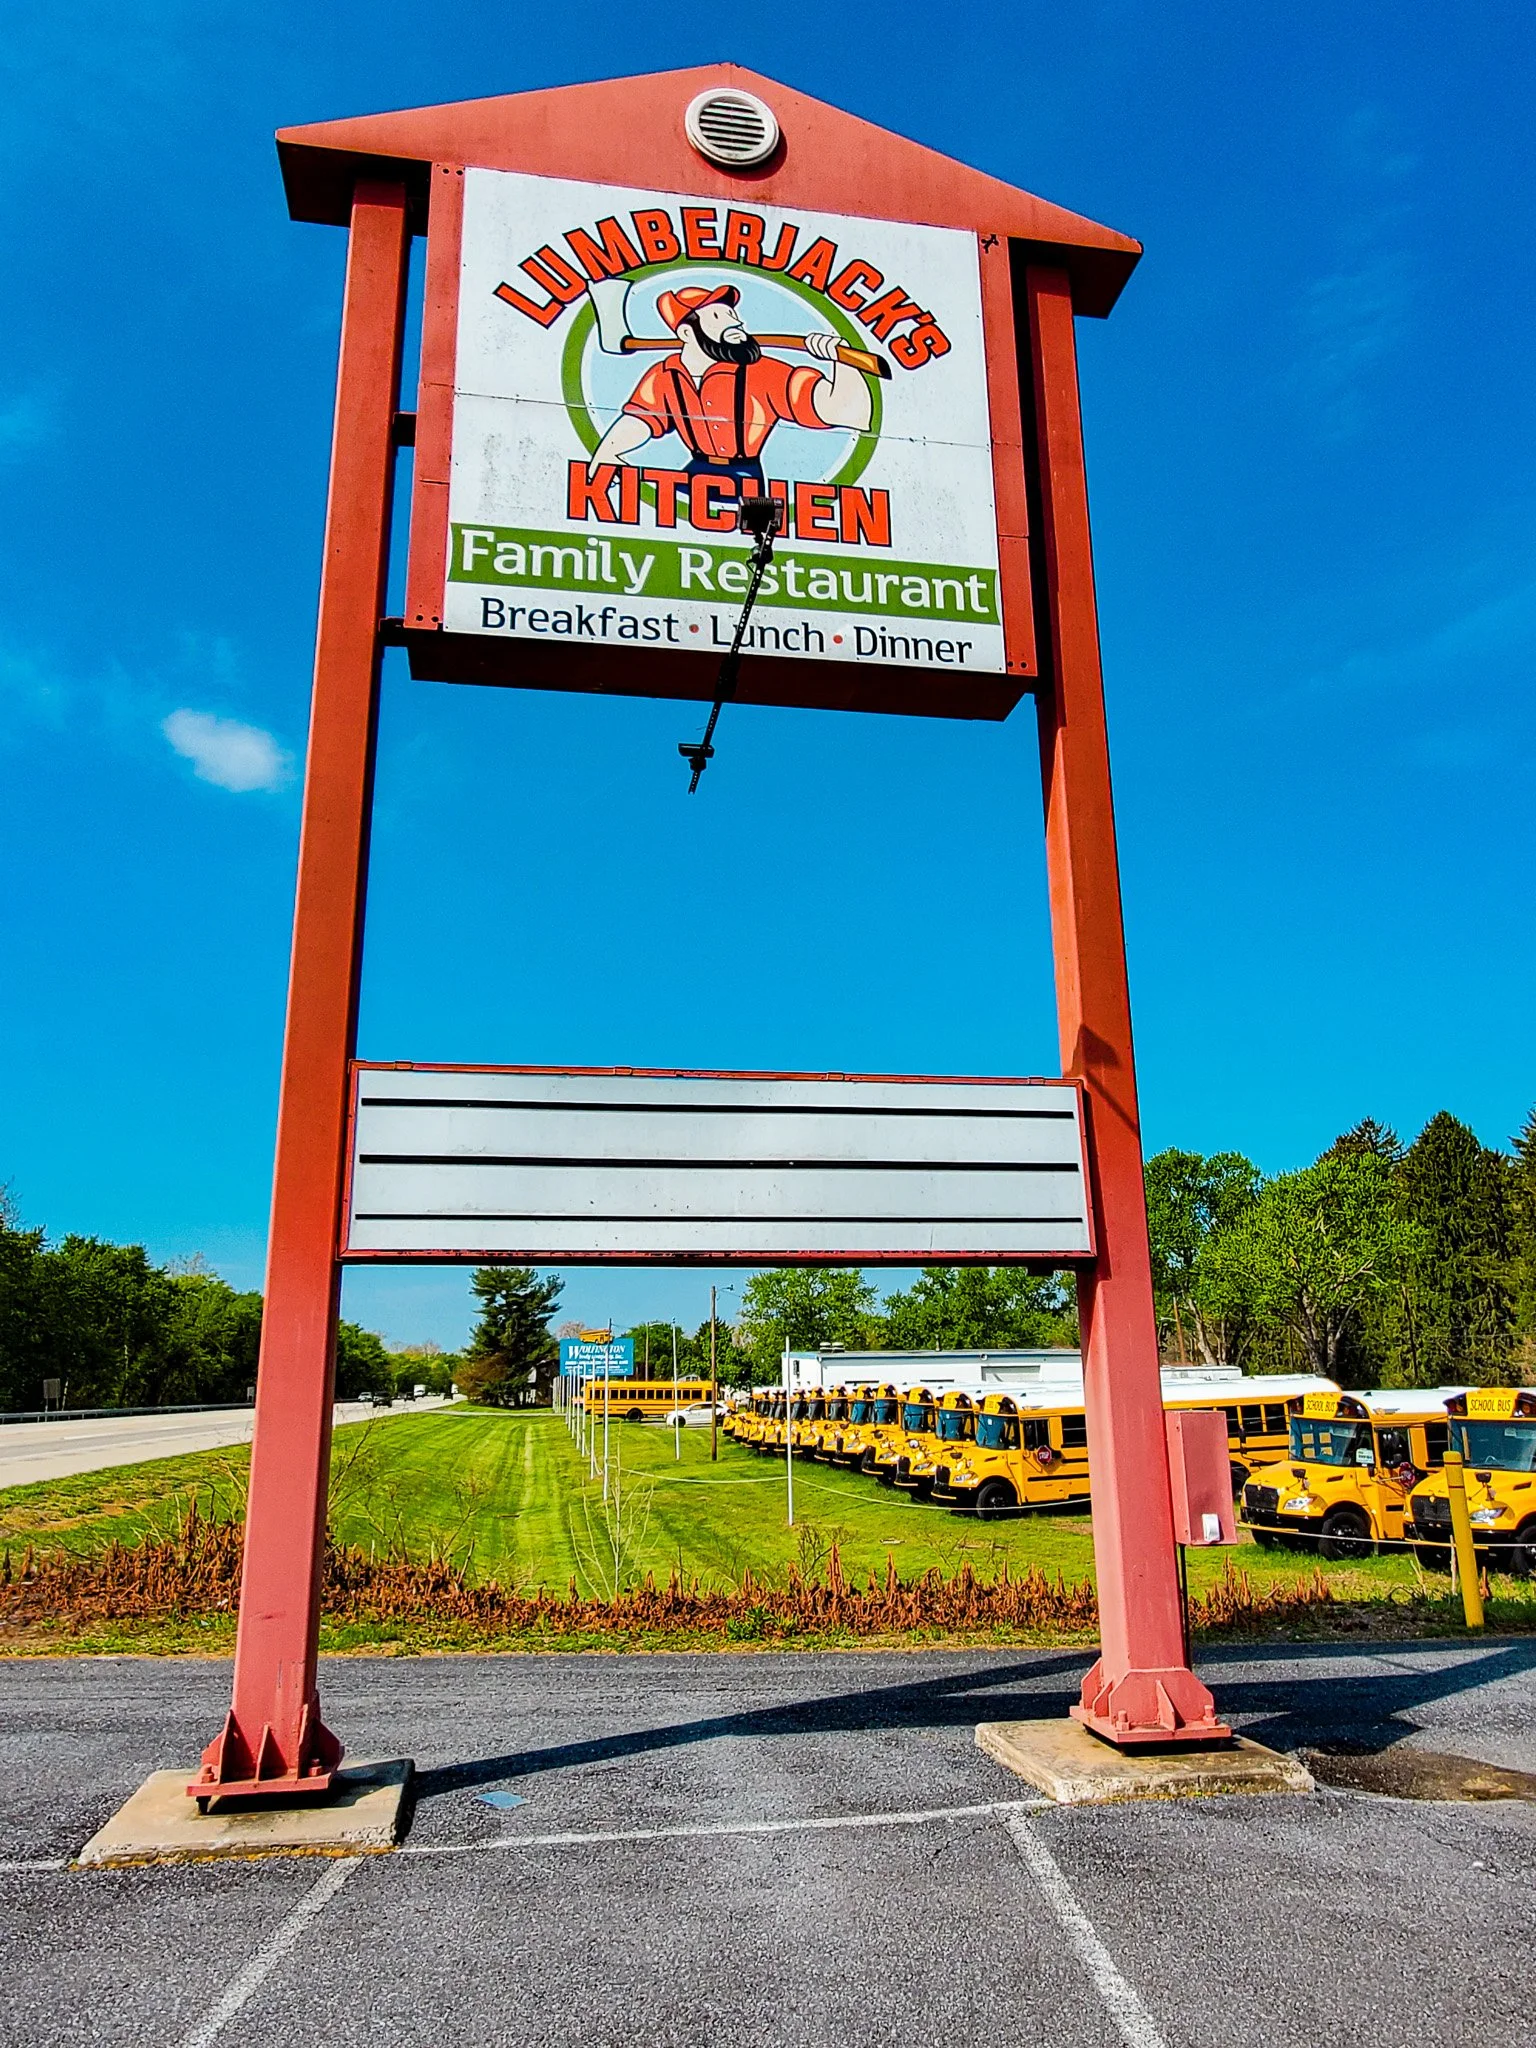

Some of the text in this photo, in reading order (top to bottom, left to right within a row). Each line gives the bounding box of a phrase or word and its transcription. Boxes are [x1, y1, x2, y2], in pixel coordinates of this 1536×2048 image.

[493, 206, 952, 370] LUMBERJACK'S
[461, 529, 990, 613] Family Restaurant
[481, 597, 973, 663] Breakfast Lunch Dinner
[1306, 1400, 1336, 1412] SCHOOL BUS
[1470, 1399, 1511, 1411] SCHOOL BUS
